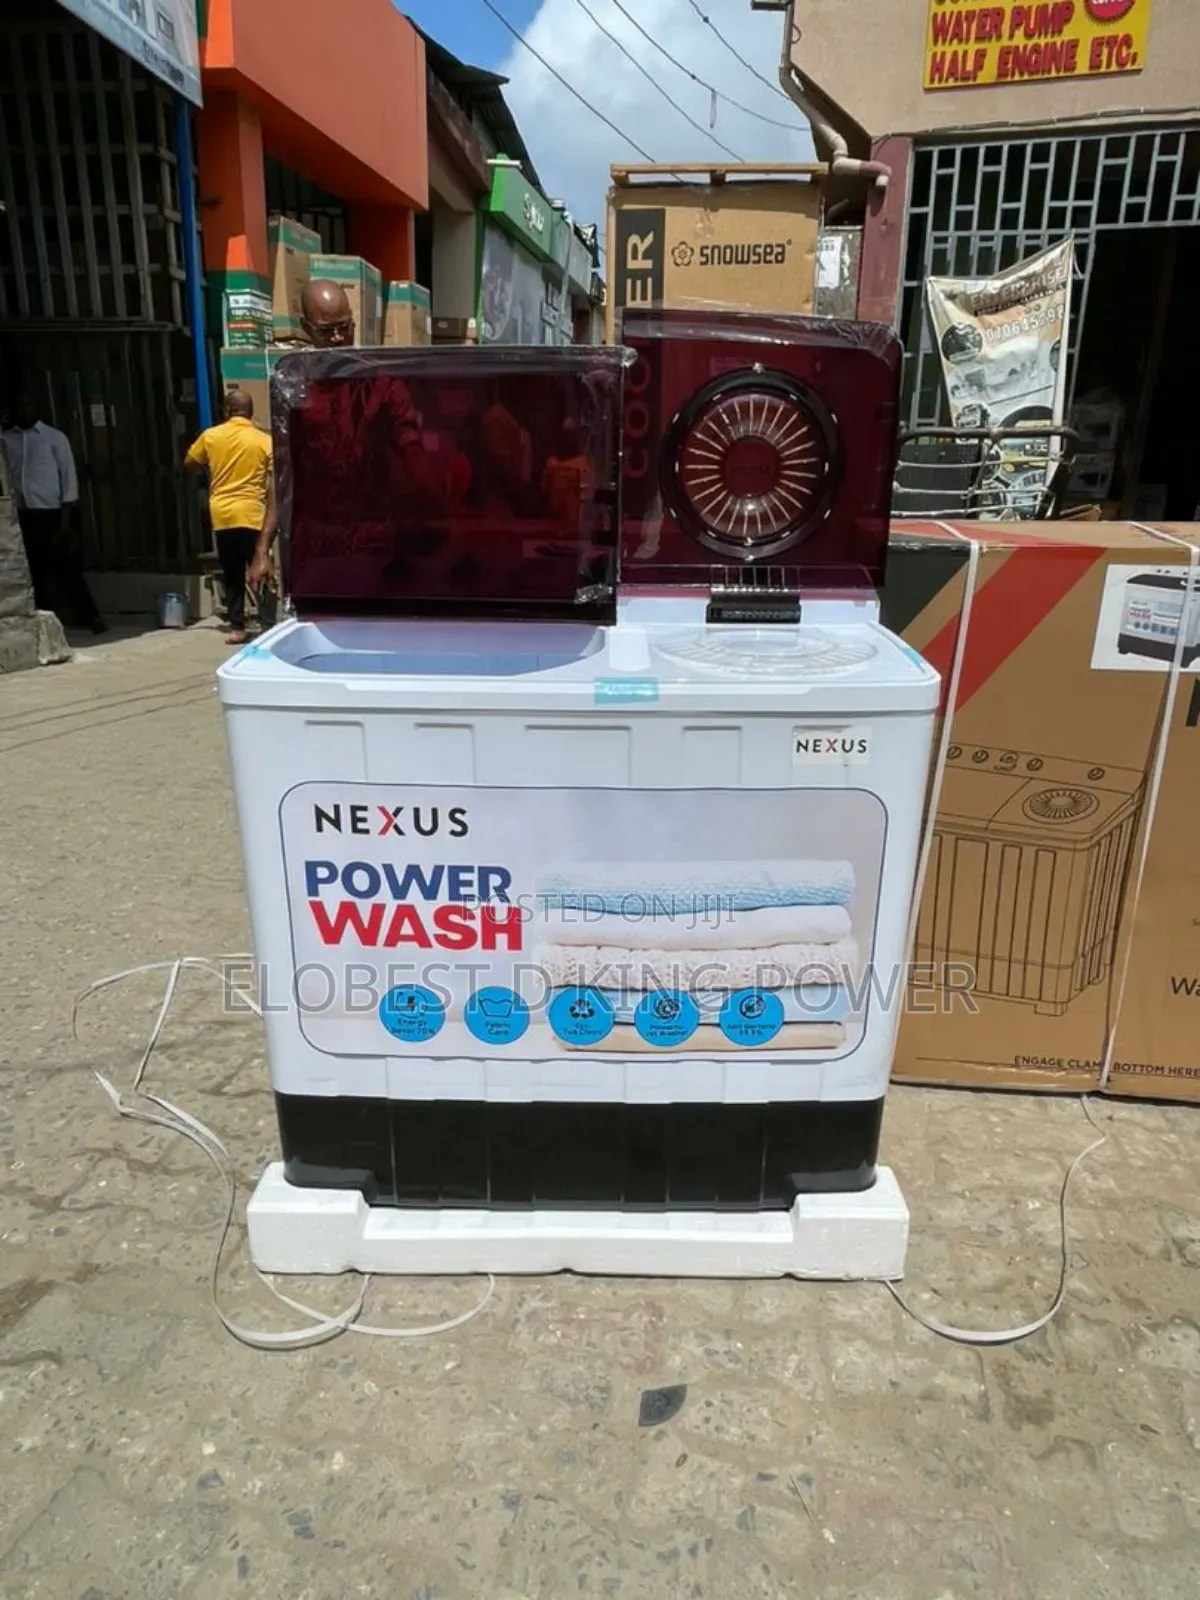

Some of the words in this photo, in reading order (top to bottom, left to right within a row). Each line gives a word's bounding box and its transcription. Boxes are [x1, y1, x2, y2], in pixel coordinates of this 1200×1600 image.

[932, 6, 1005, 46] WATER
[1008, 0, 1074, 40] PUMP
[930, 48, 987, 84] HALF
[996, 39, 1079, 80] ENGINE
[1089, 33, 1138, 71] ETC.
[796, 738, 867, 753] NEXUS
[314, 803, 469, 837] NEXUS
[304, 860, 512, 903] POWER
[309, 901, 523, 951] WASH
[1014, 1055, 1064, 1067] ENGAGE
[1067, 1059, 1103, 1070] CLAM
[1113, 1062, 1164, 1075] BOTTOM
